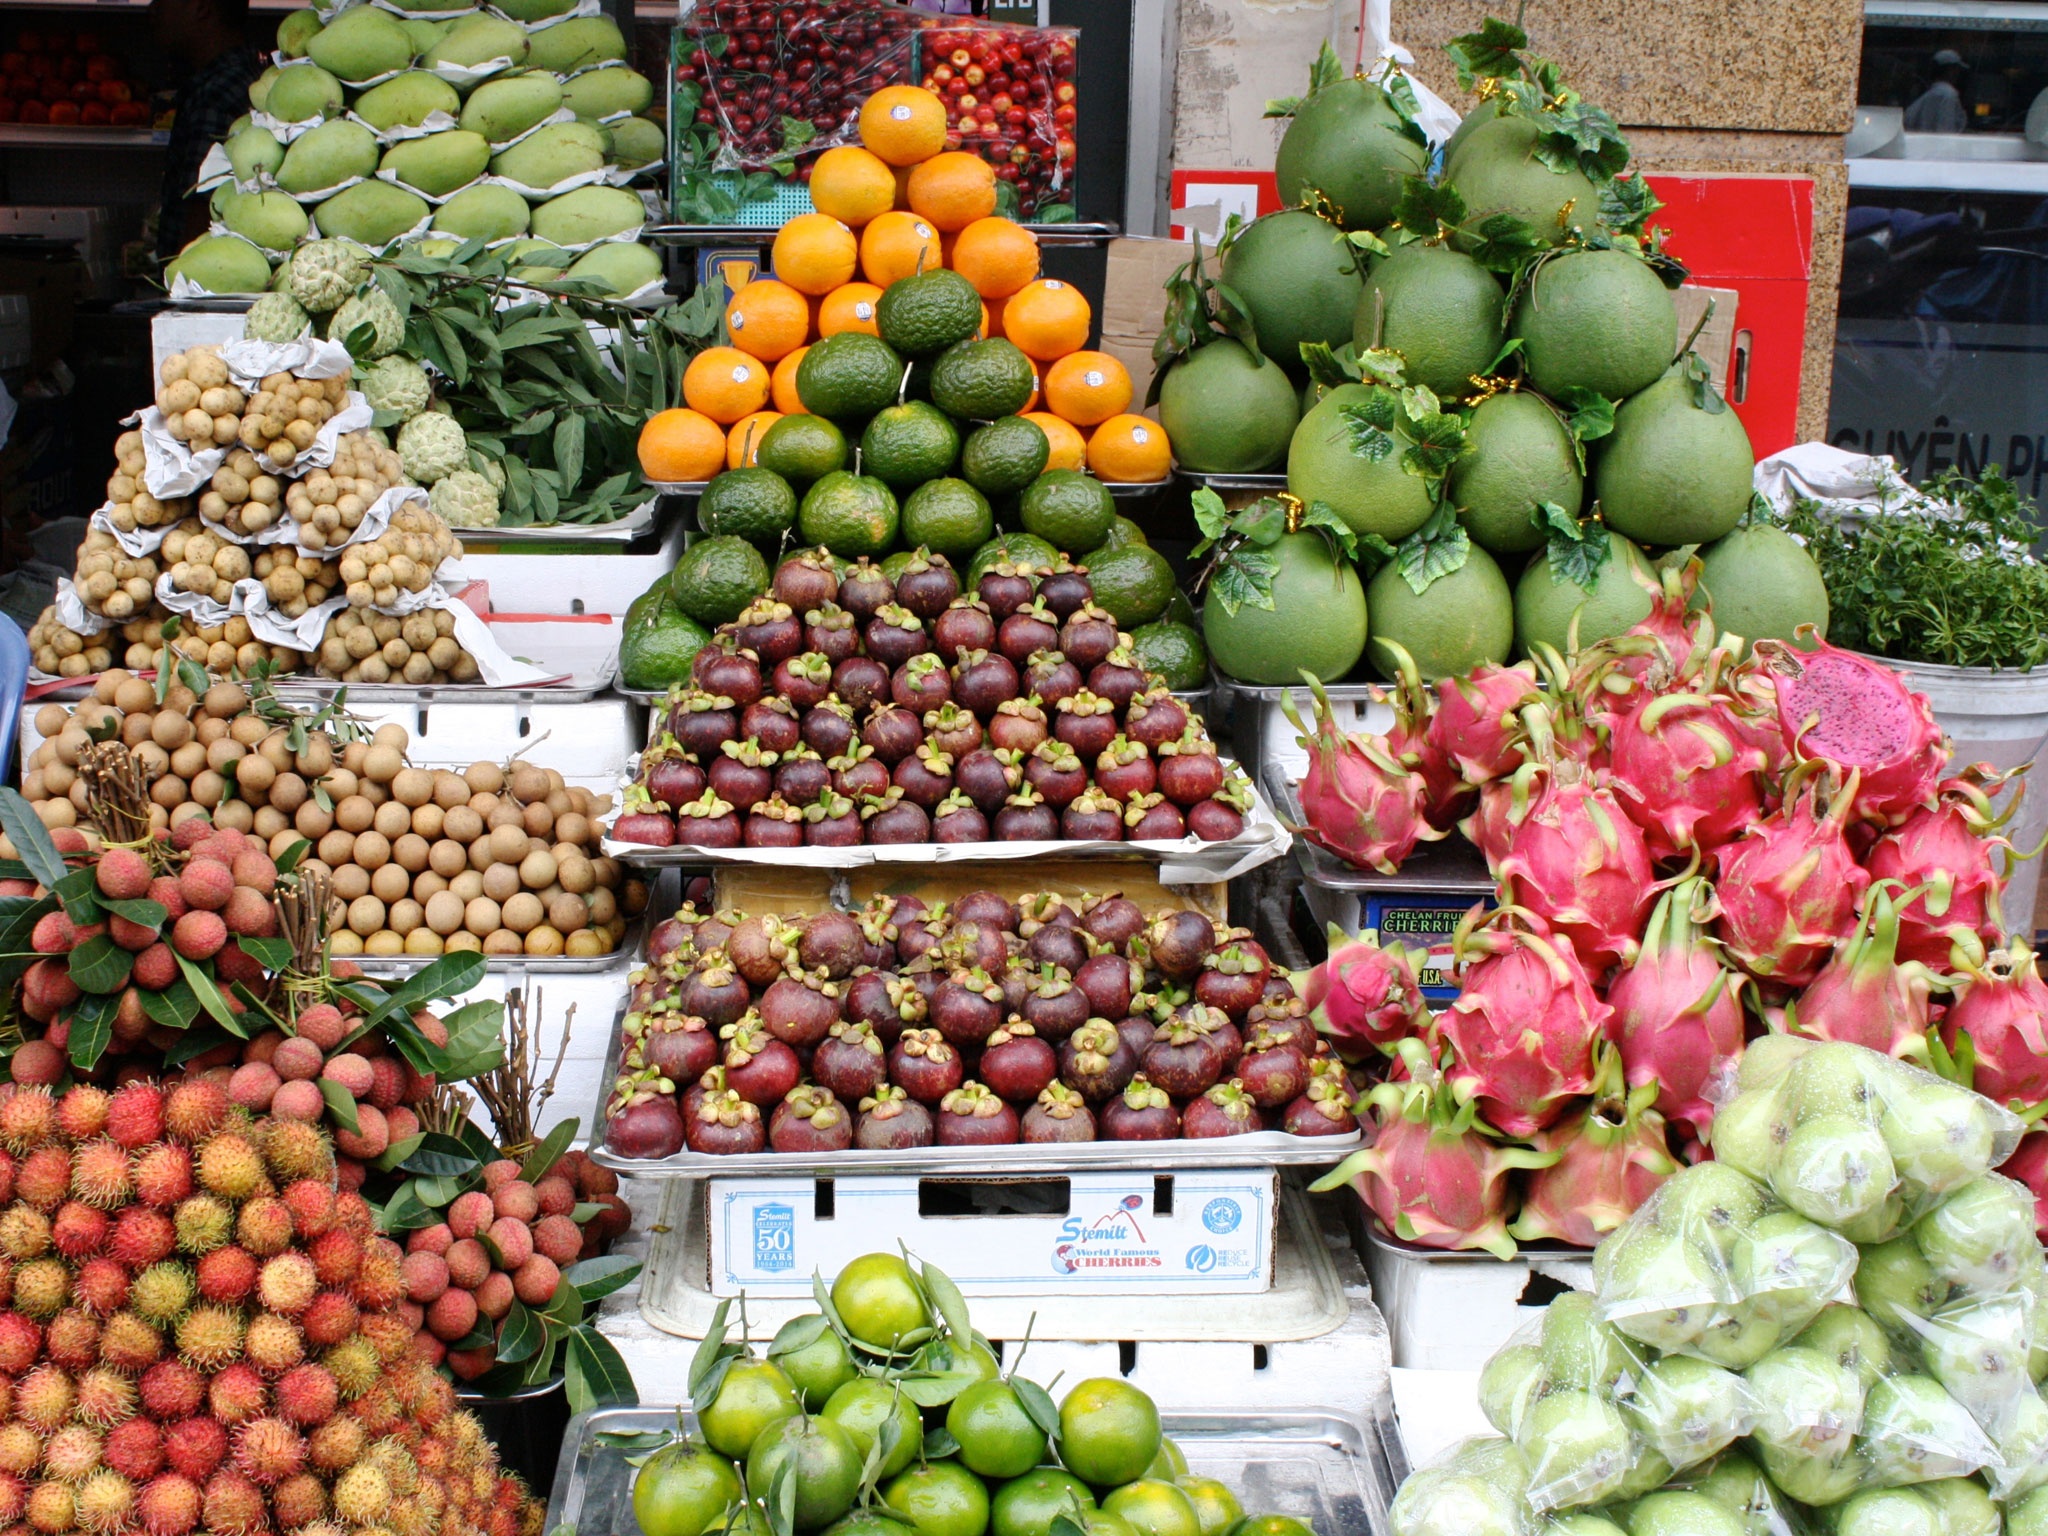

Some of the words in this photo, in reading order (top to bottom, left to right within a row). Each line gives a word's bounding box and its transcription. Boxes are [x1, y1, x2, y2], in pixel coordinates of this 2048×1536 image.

[1389, 911, 1433, 919] CHELAN
[1437, 912, 1464, 920] FRUI
[1384, 919, 1460, 932] CHERRIE
[1422, 969, 1442, 985] U.S.A.
[756, 1209, 791, 1221] Stemilt
[1055, 1216, 1128, 1244] Stemilt
[756, 1228, 791, 1251] 50
[756, 1253, 793, 1261] YEARS
[1076, 1248, 1110, 1257] World
[1113, 1248, 1160, 1257] Famous
[1074, 1257, 1162, 1267] CHERRIES
